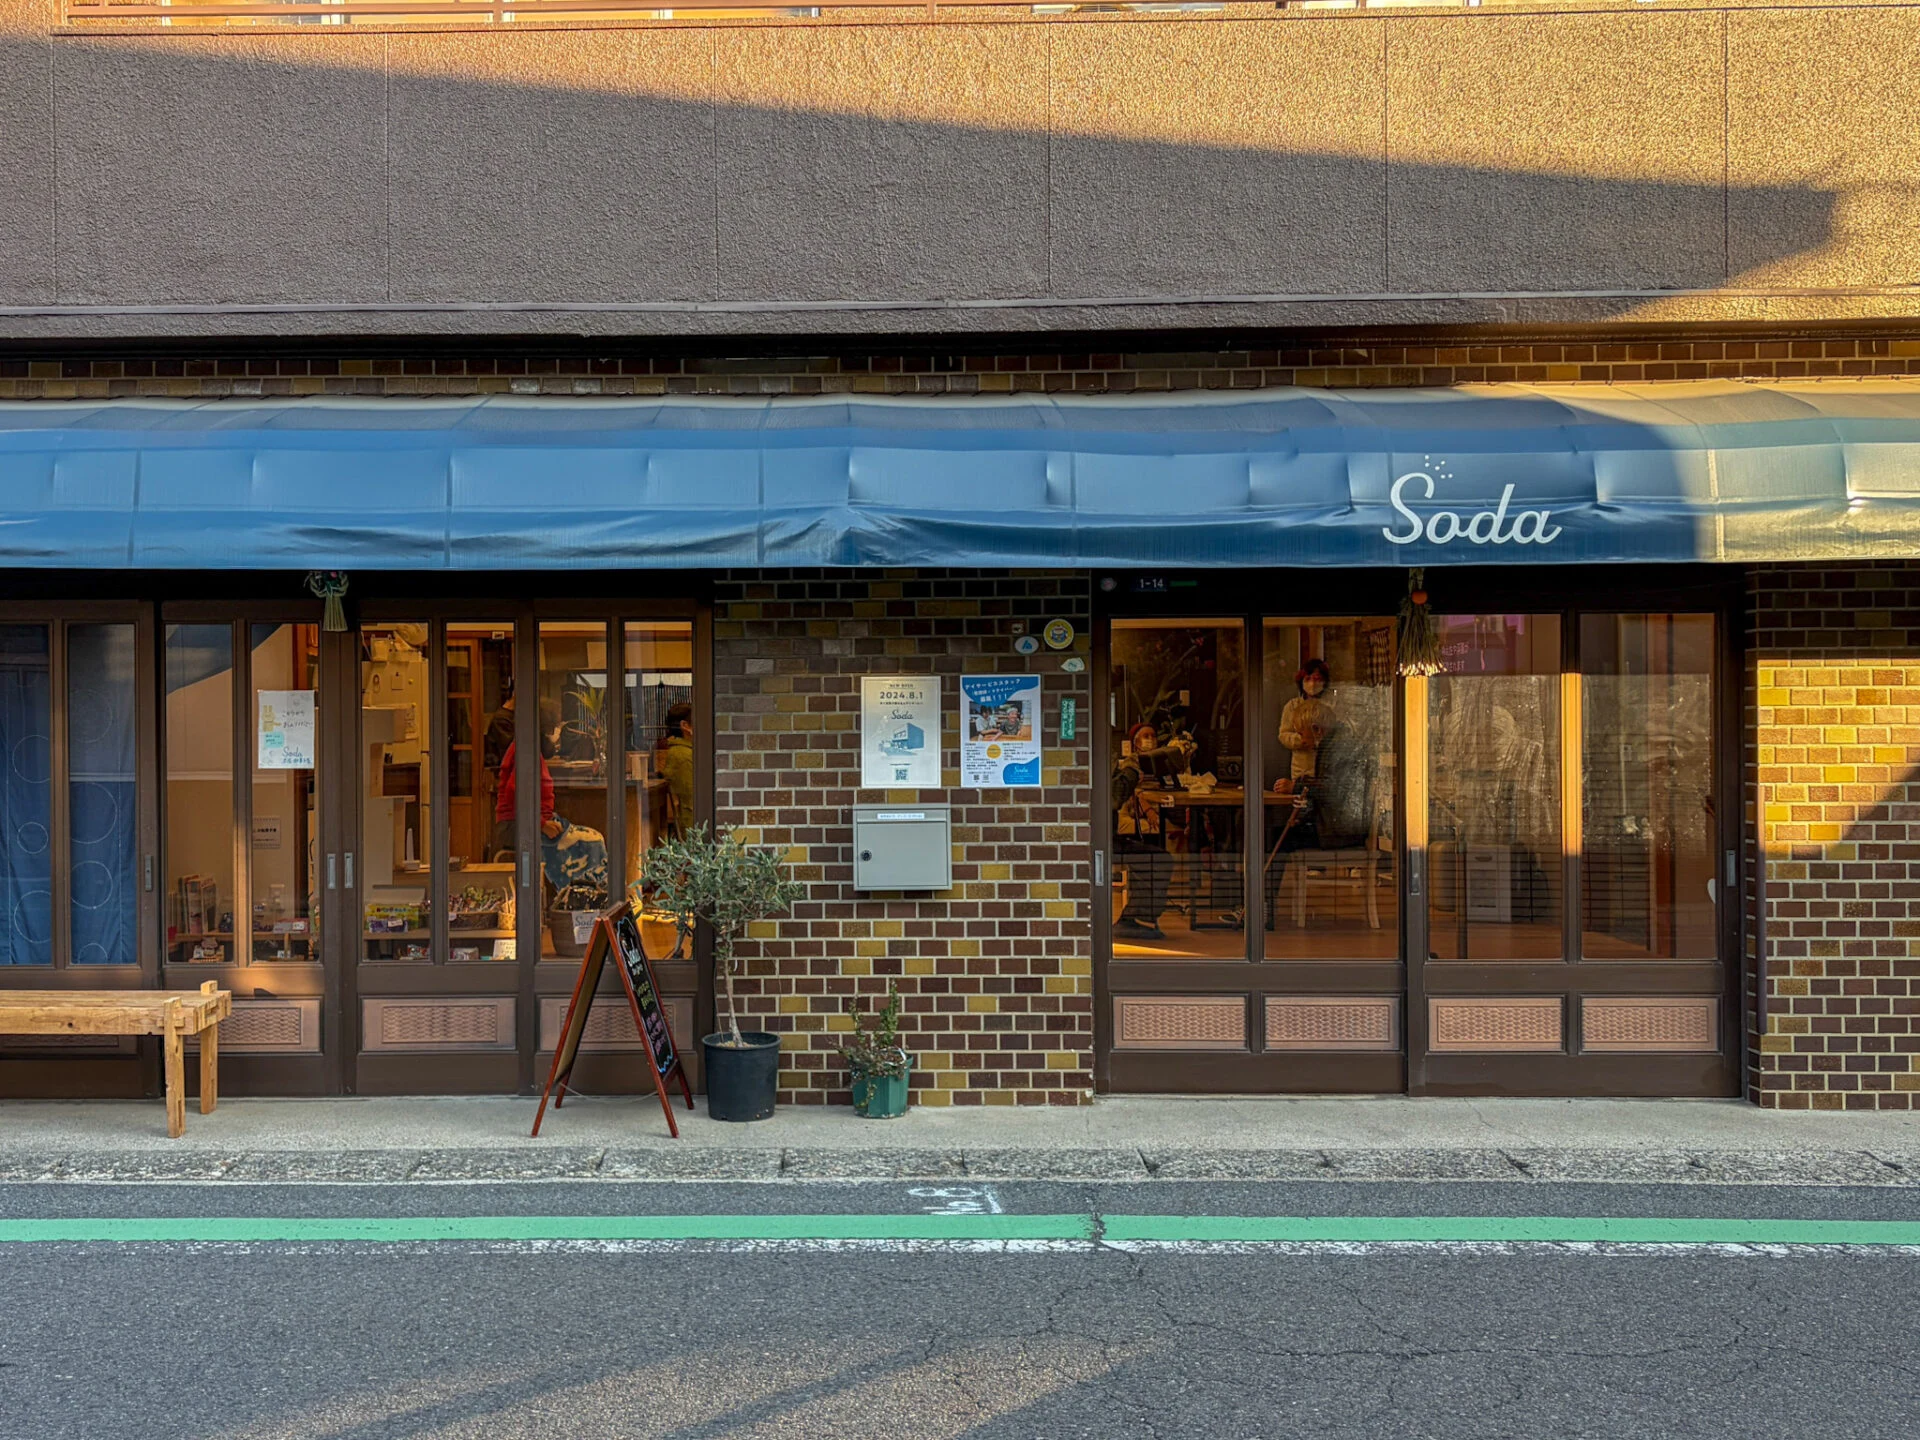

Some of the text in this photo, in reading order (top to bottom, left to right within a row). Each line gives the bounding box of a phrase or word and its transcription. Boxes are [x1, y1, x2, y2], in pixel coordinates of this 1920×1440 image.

[1382, 472, 1562, 544] Soda
[1140, 578, 1164, 588] 1-14
[880, 691, 923, 699] 2024.8.1
[891, 709, 914, 720] Soda
